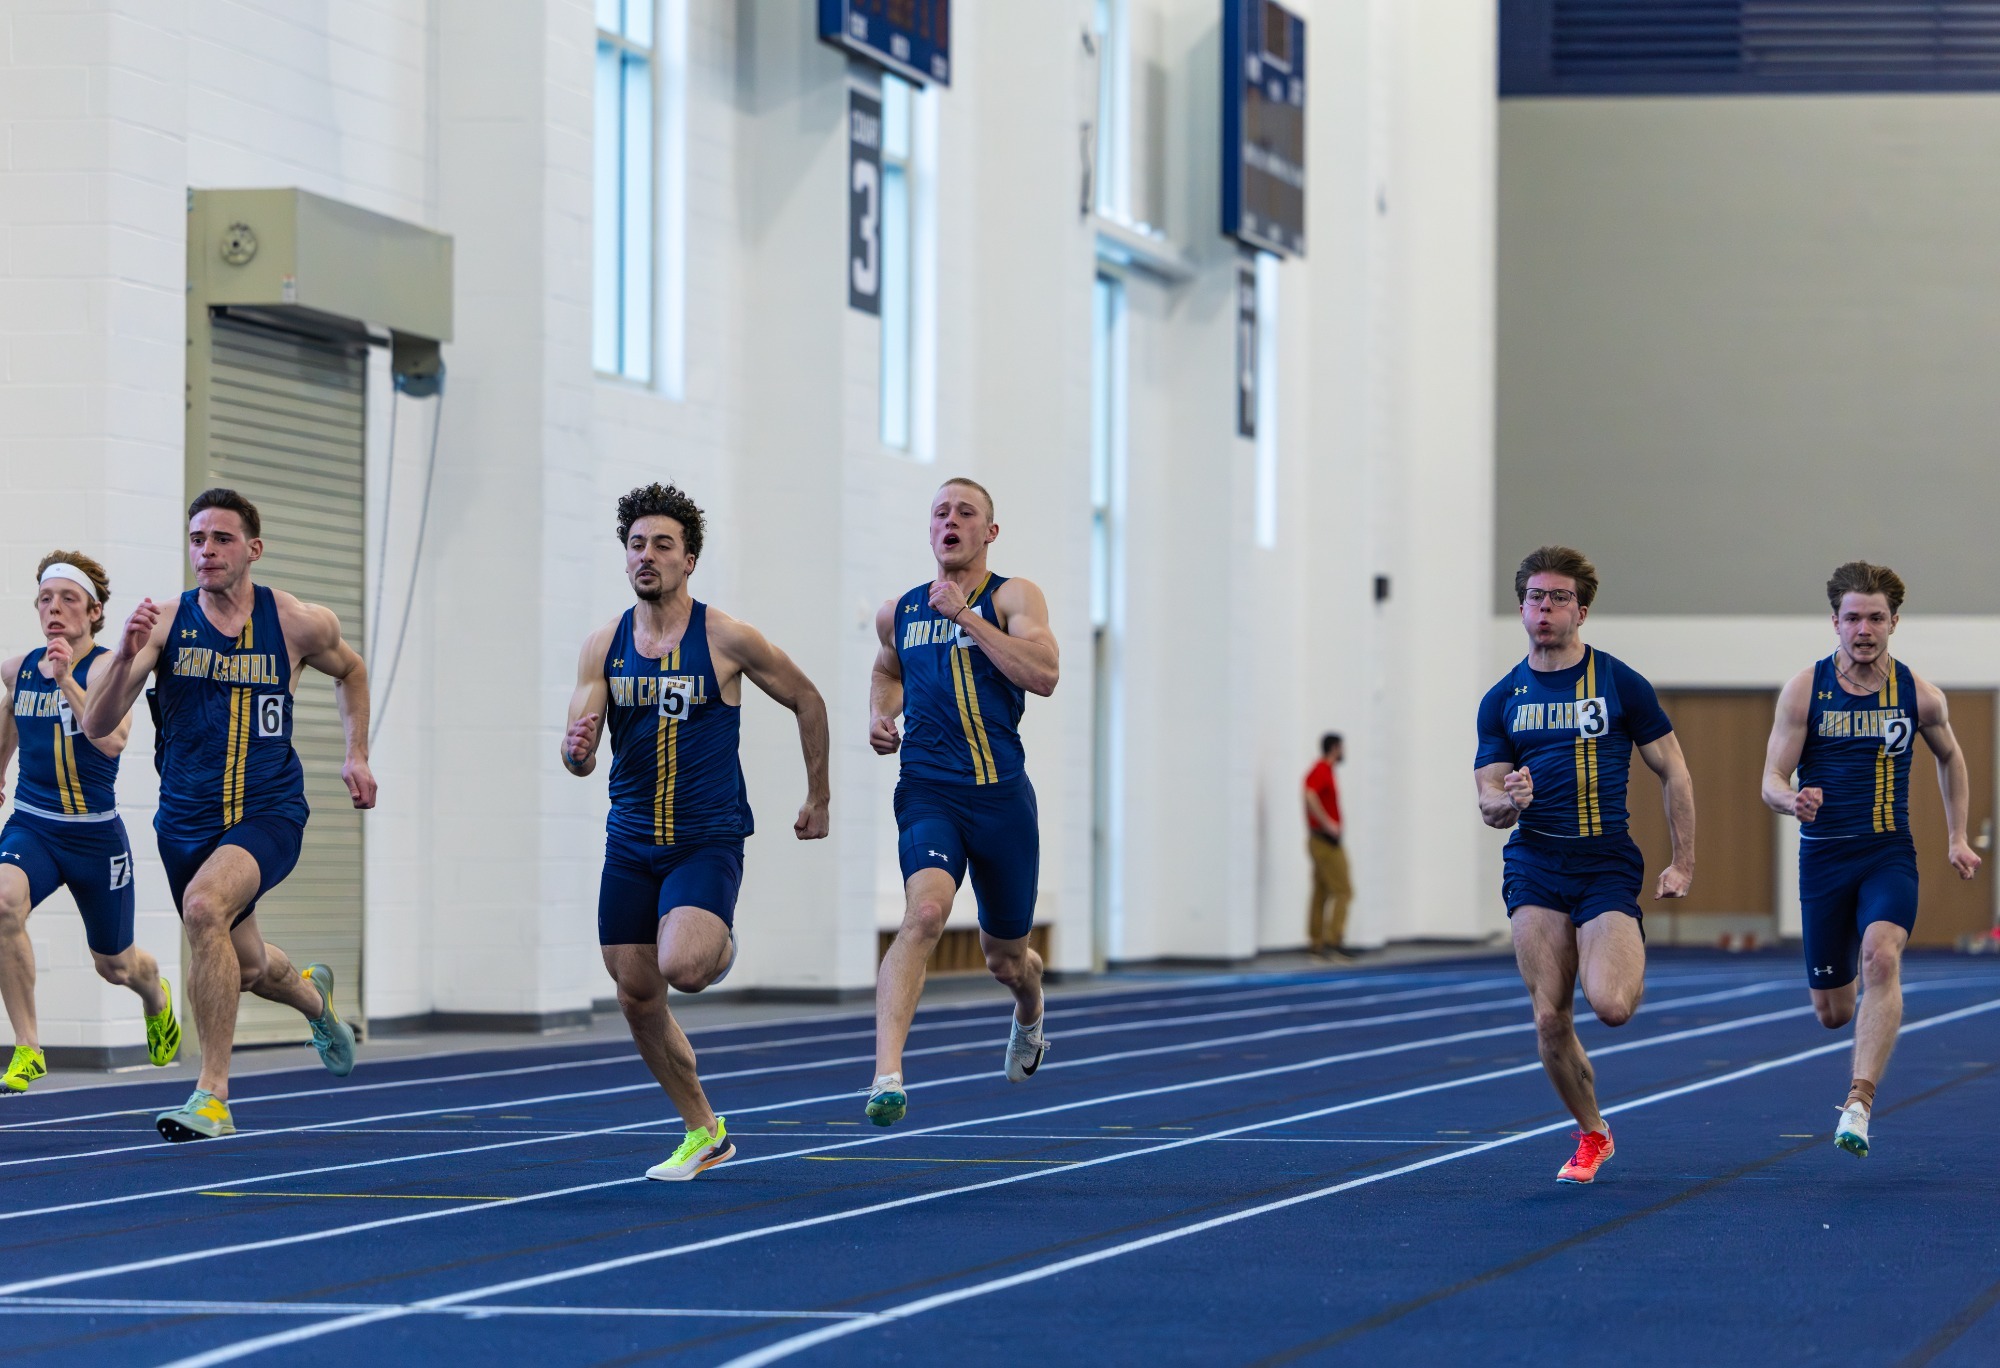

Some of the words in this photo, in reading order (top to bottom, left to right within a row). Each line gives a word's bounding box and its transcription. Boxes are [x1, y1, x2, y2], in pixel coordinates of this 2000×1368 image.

[852, 157, 879, 297] 3
[903, 620, 931, 649] JOHN
[173, 647, 212, 678] JOHN
[212, 651, 279, 685] CARROLL
[663, 681, 686, 715] 5
[261, 697, 280, 734] 6
[1513, 703, 1544, 732] JOHN
[1581, 700, 1605, 735] 3
[1819, 711, 1850, 737] JOHN
[1887, 720, 1908, 753] 2
[113, 856, 127, 887] 7
